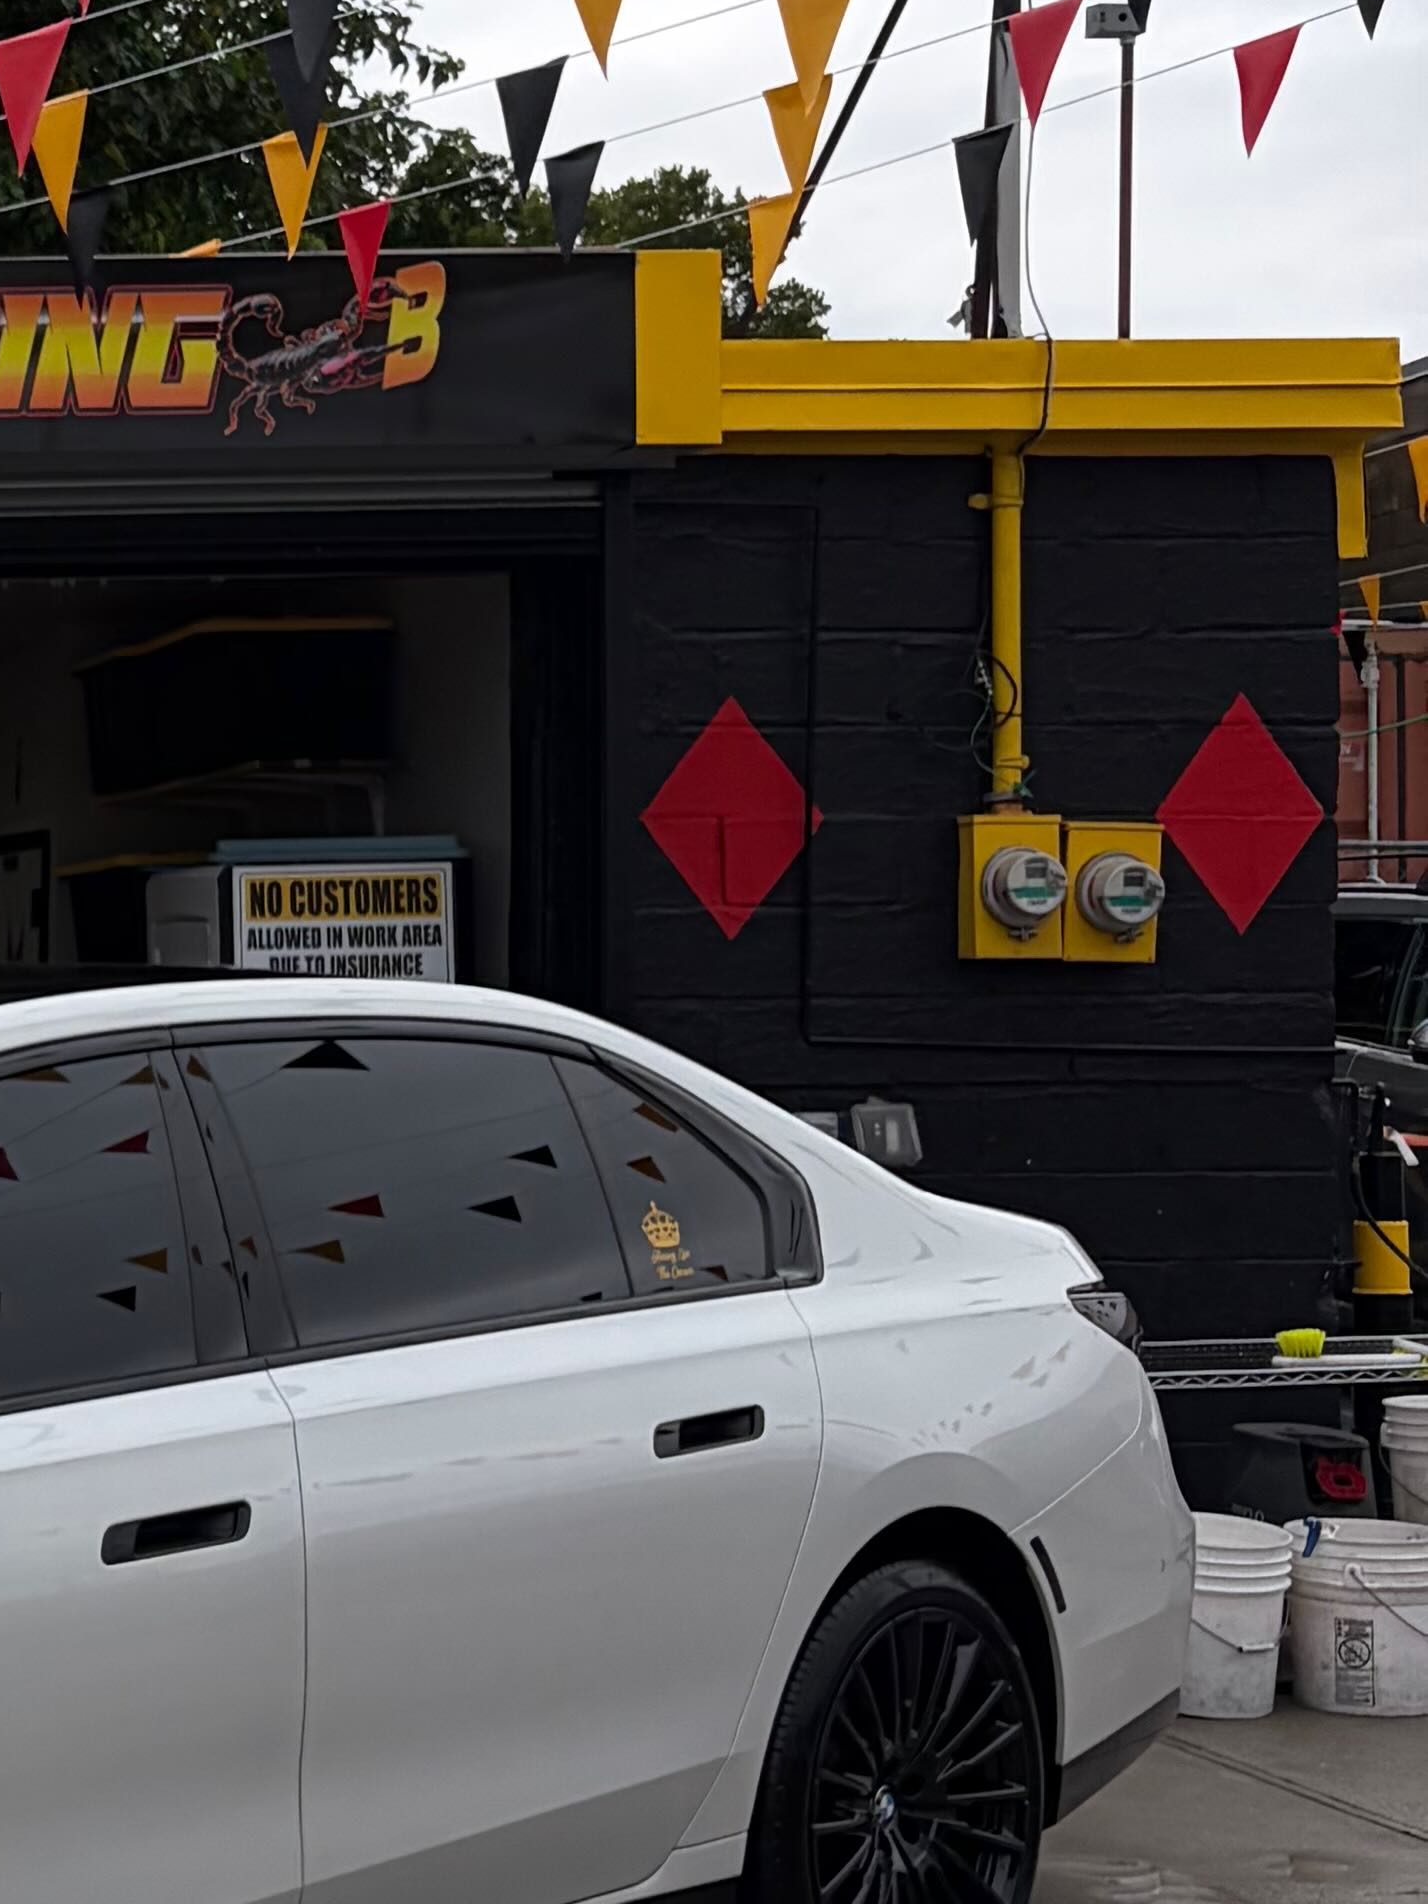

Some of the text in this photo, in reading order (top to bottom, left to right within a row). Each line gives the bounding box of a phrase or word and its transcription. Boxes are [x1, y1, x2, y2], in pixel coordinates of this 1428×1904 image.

[249, 877, 439, 917] NO CUSTOMERS
[247, 924, 442, 950] ALLOWED IN WORK AREA
[269, 953, 423, 978] DUE TO INSURANCE
